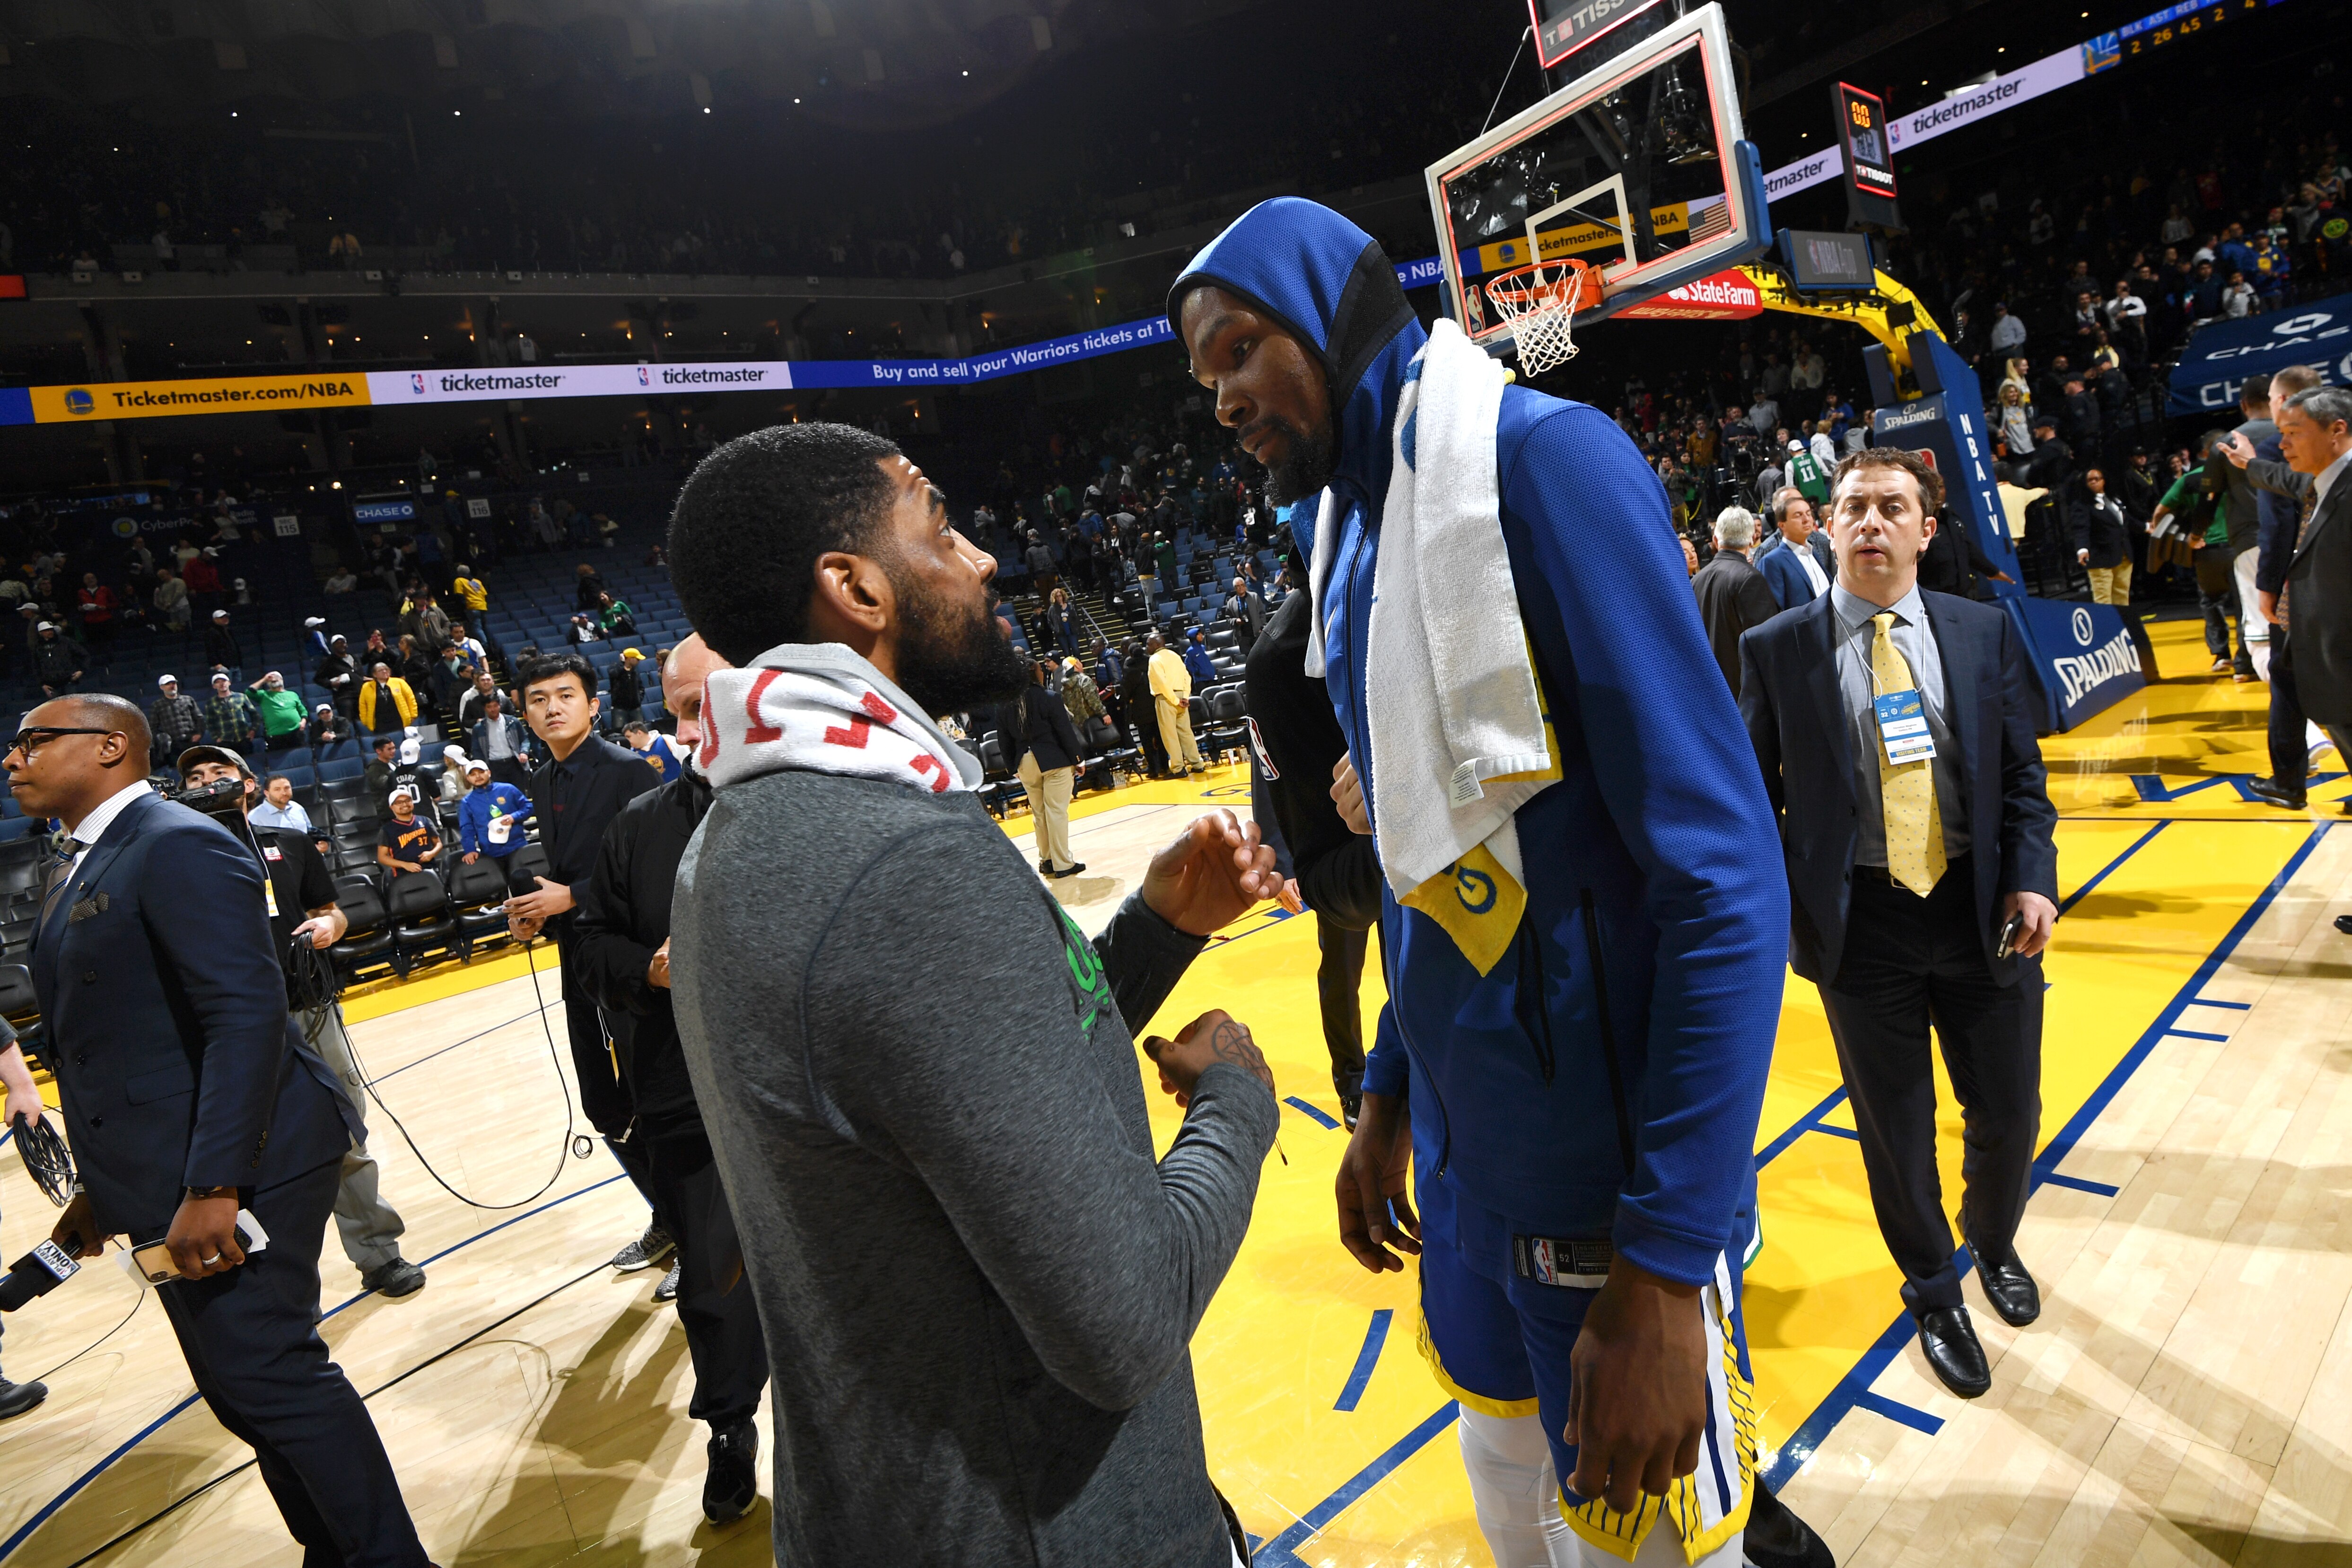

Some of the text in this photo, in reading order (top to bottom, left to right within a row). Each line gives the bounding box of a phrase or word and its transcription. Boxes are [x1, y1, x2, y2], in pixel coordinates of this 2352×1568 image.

[2130, 40, 2142, 53] 2
[2153, 28, 2173, 45] 26
[2180, 17, 2201, 34] 45
[2213, 8, 2225, 22] 2
[1913, 78, 2022, 134] ticketmaster
[1866, 166, 1893, 184] TISSOT
[1411, 260, 1444, 280] NBA
[873, 364, 903, 381] Buy
[908, 363, 938, 378] and
[943, 362, 969, 377] sell
[972, 356, 1008, 377] your
[1011, 341, 1080, 366] Warriors
[1083, 330, 1134, 350] tickets
[1137, 324, 1152, 338] at
[440, 374, 561, 392] ticketmaster
[662, 367, 765, 384] ticketmaster
[113, 382, 353, 408] Ticketmaster.com/NBA
[1885, 407, 1935, 430] SPALDING
[1801, 465, 1816, 483] 11
[1959, 413, 2000, 536] NBA TV
[356, 507, 400, 518] CHASE
[279, 525, 296, 534] 115
[2054, 627, 2141, 709] SPALDING
[1896, 749, 1915, 757] VISITING
[396, 775, 416, 784] CURRY
[398, 827, 428, 849] WARRIORS
[418, 836, 428, 846] 37
[36, 1248, 62, 1272] PLAYERS
[44, 1245, 70, 1267] ONLY
[1559, 1254, 1570, 1262] 52
